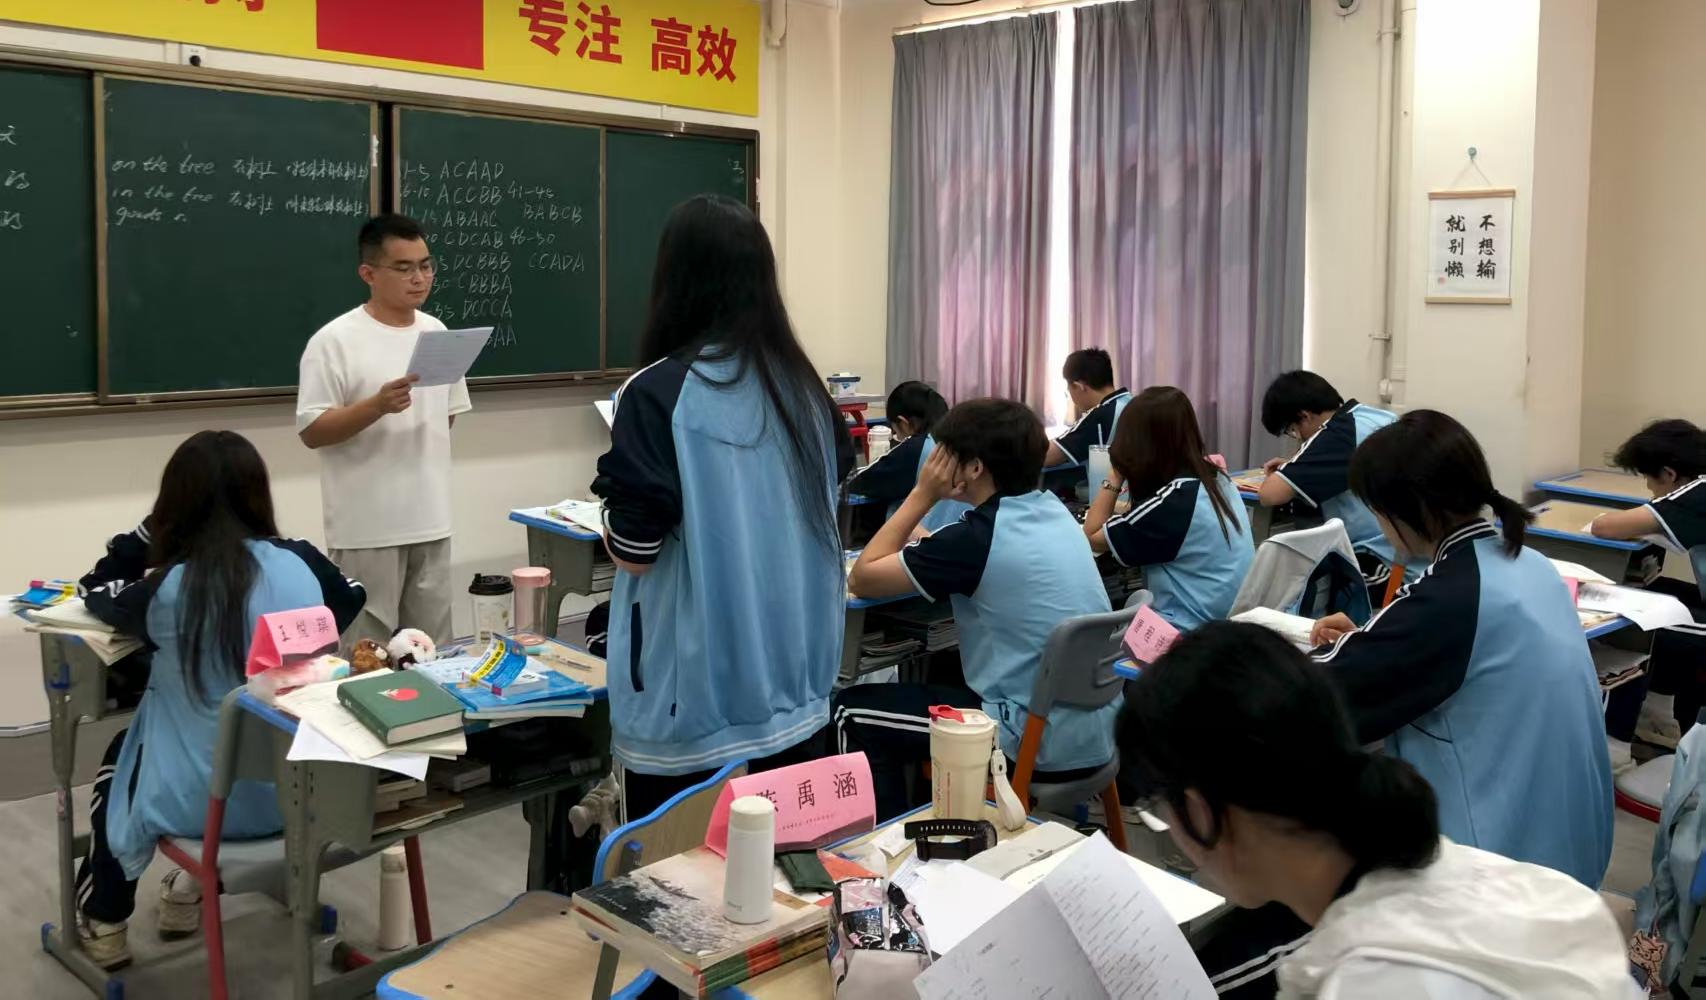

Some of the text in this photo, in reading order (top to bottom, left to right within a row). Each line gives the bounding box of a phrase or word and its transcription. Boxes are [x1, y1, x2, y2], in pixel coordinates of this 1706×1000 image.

[519, 0, 737, 83] 专注 高效
[111, 154, 216, 175] on the tree
[404, 160, 504, 183] 1-5 ACAAD
[112, 187, 134, 198] in
[144, 184, 175, 199] the
[437, 184, 503, 206] ACCBB
[507, 181, 555, 200] 41-45
[442, 209, 498, 228] ABAAC
[523, 203, 583, 225] BABCB
[444, 232, 504, 249] CDCAB
[1444, 214, 1467, 279] 就别懒
[1476, 214, 1497, 280] 不想输
[453, 252, 512, 273] DCBBB
[528, 252, 585, 273] CCADA
[487, 325, 518, 347] AA
